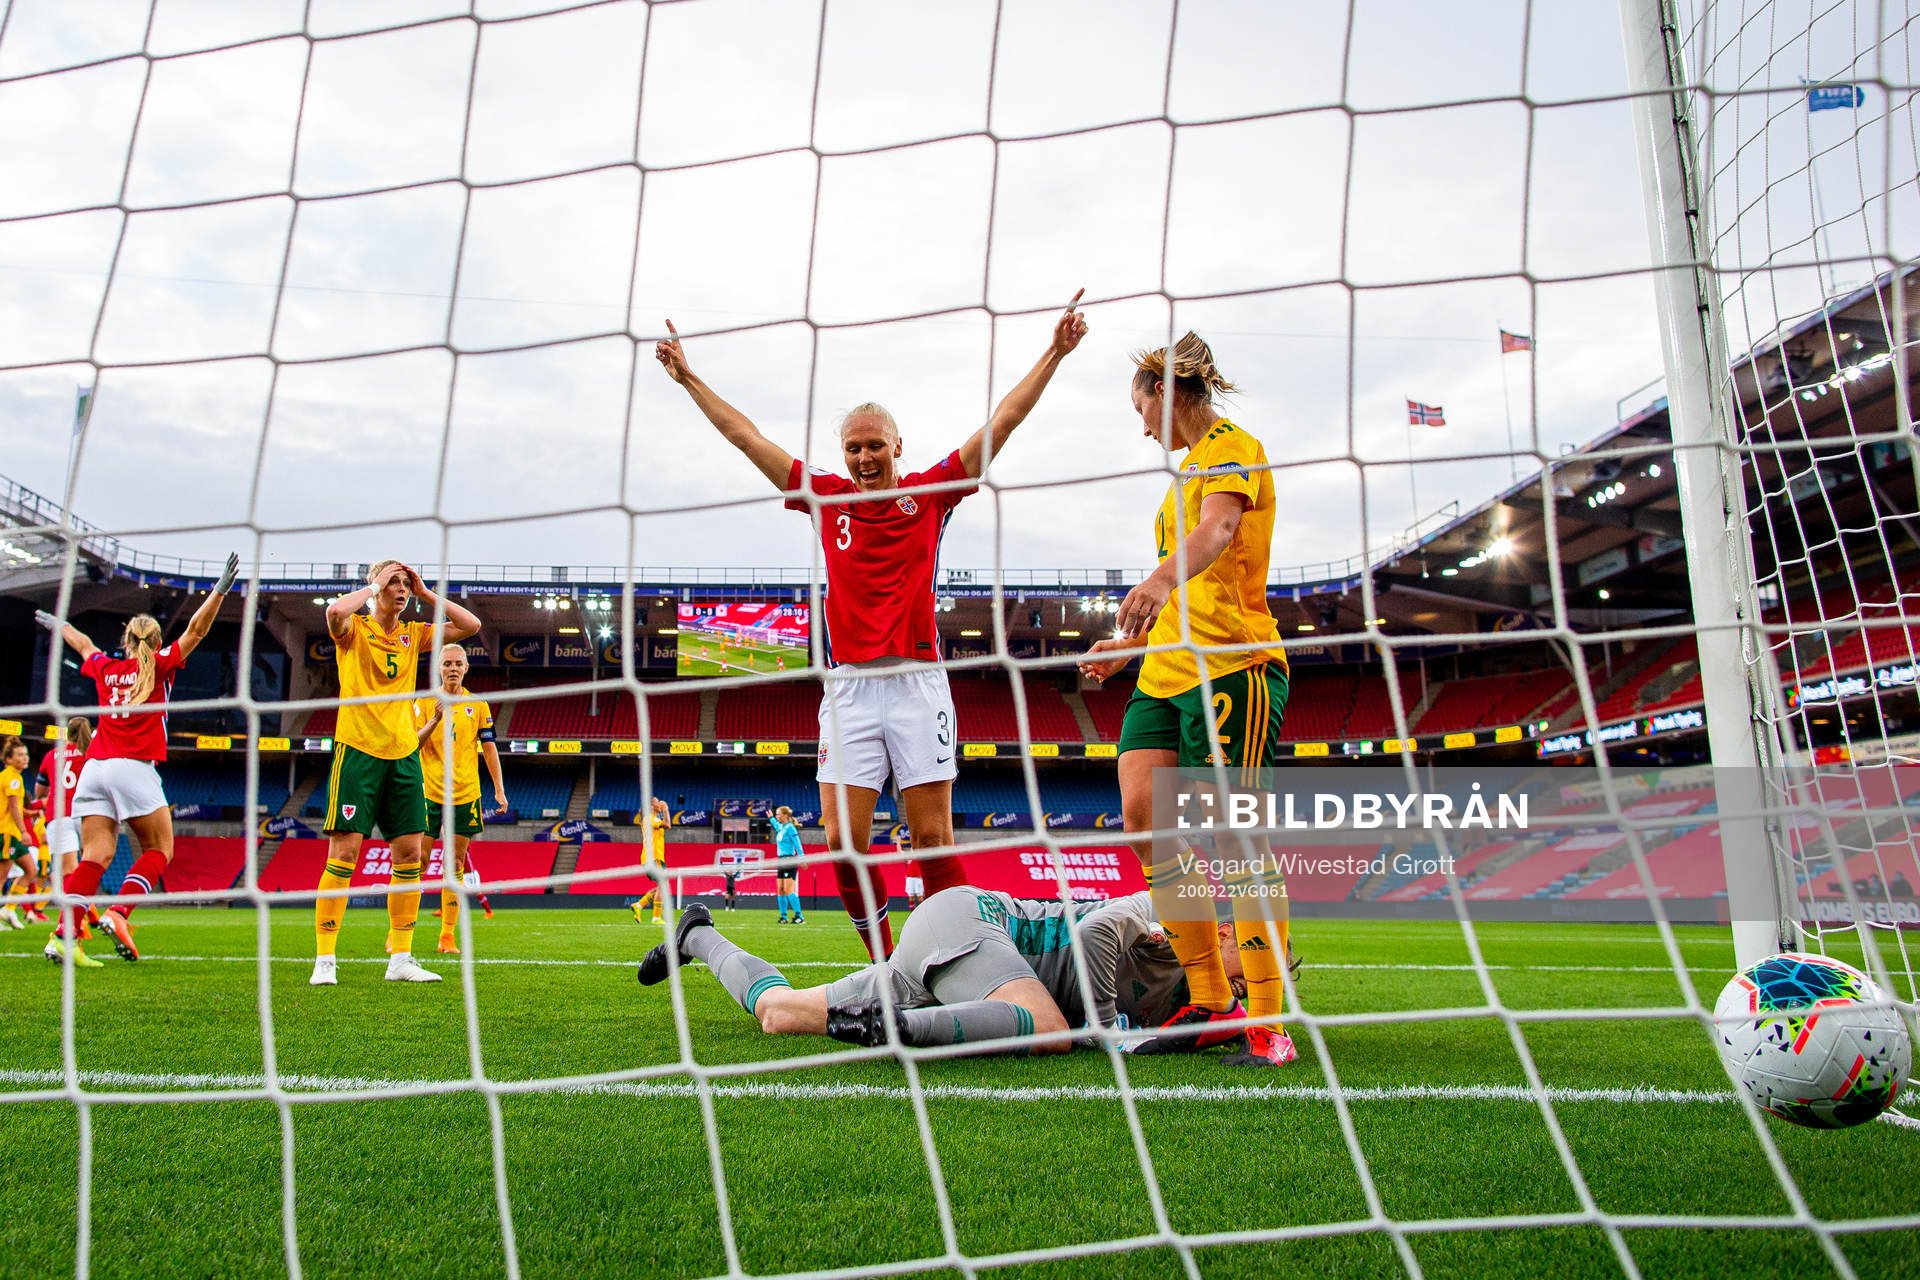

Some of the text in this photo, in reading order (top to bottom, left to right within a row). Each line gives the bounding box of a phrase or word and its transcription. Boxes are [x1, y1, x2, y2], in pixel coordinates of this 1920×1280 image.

[836, 515, 852, 550] 3
[386, 653, 398, 680] 5
[937, 711, 950, 746] 3
[1210, 692, 1233, 744] 2
[671, 743, 697, 752] MOVE
[62, 759, 77, 789] 6
[560, 820, 588, 837] Bendit
[680, 810, 706, 825] Bendit
[991, 812, 1018, 827] Bendit
[1047, 812, 1073, 827] Bendit
